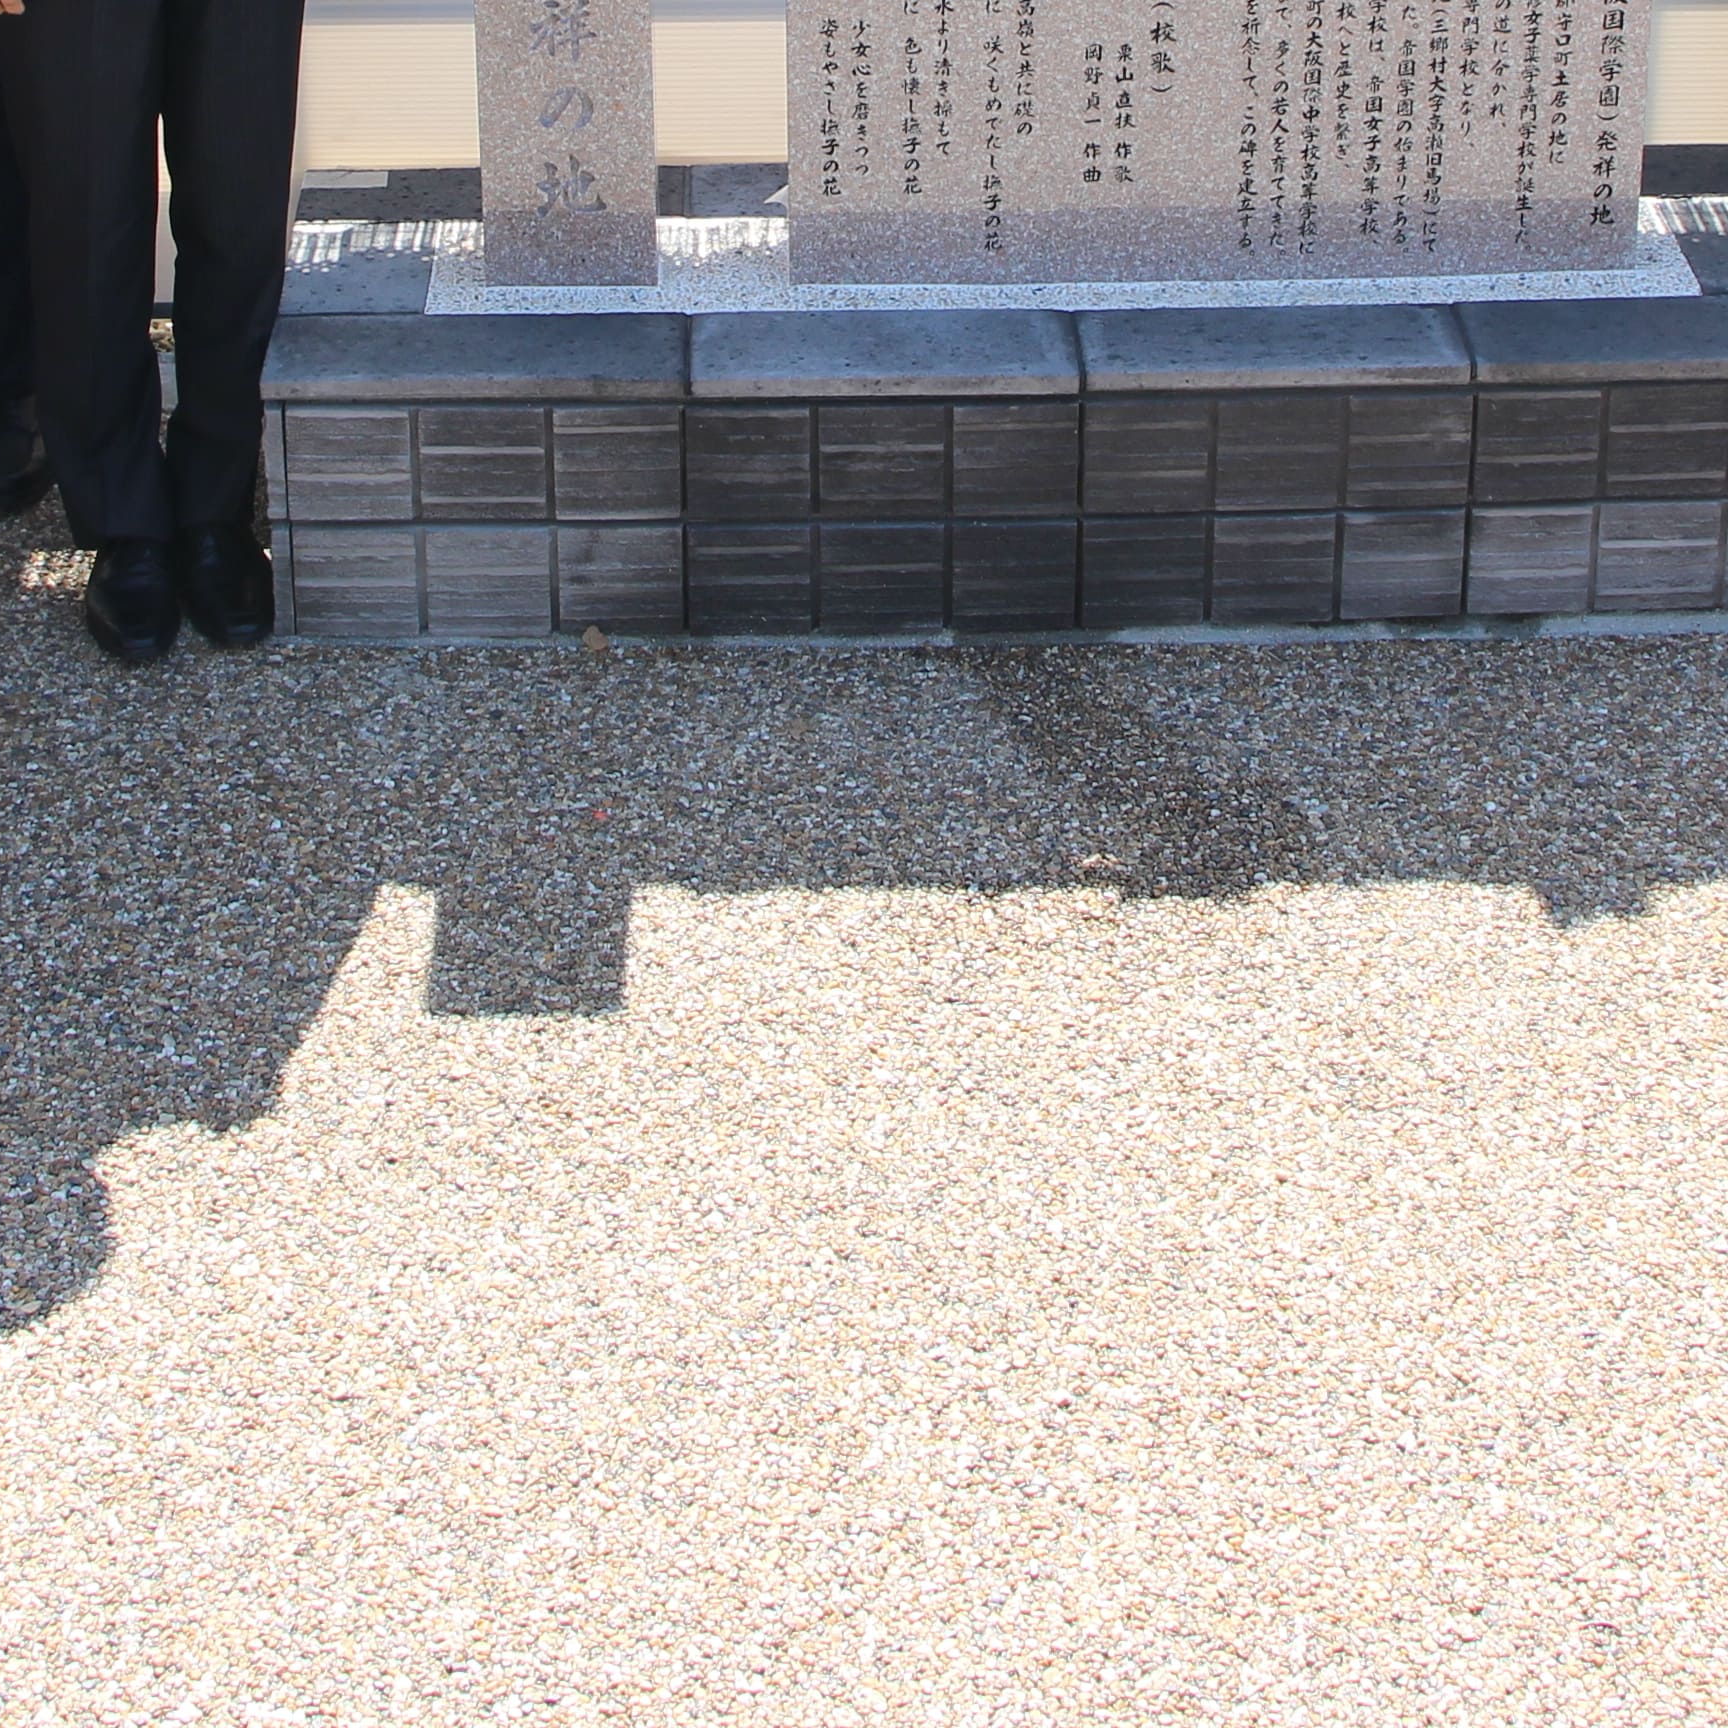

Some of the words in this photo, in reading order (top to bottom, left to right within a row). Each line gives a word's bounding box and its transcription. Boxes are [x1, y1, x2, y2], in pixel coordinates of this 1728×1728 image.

[1083, 43, 1104, 125] 岡野貞一
[1082, 142, 1102, 183] 作曲
[1114, 142, 1135, 183] 作歌
